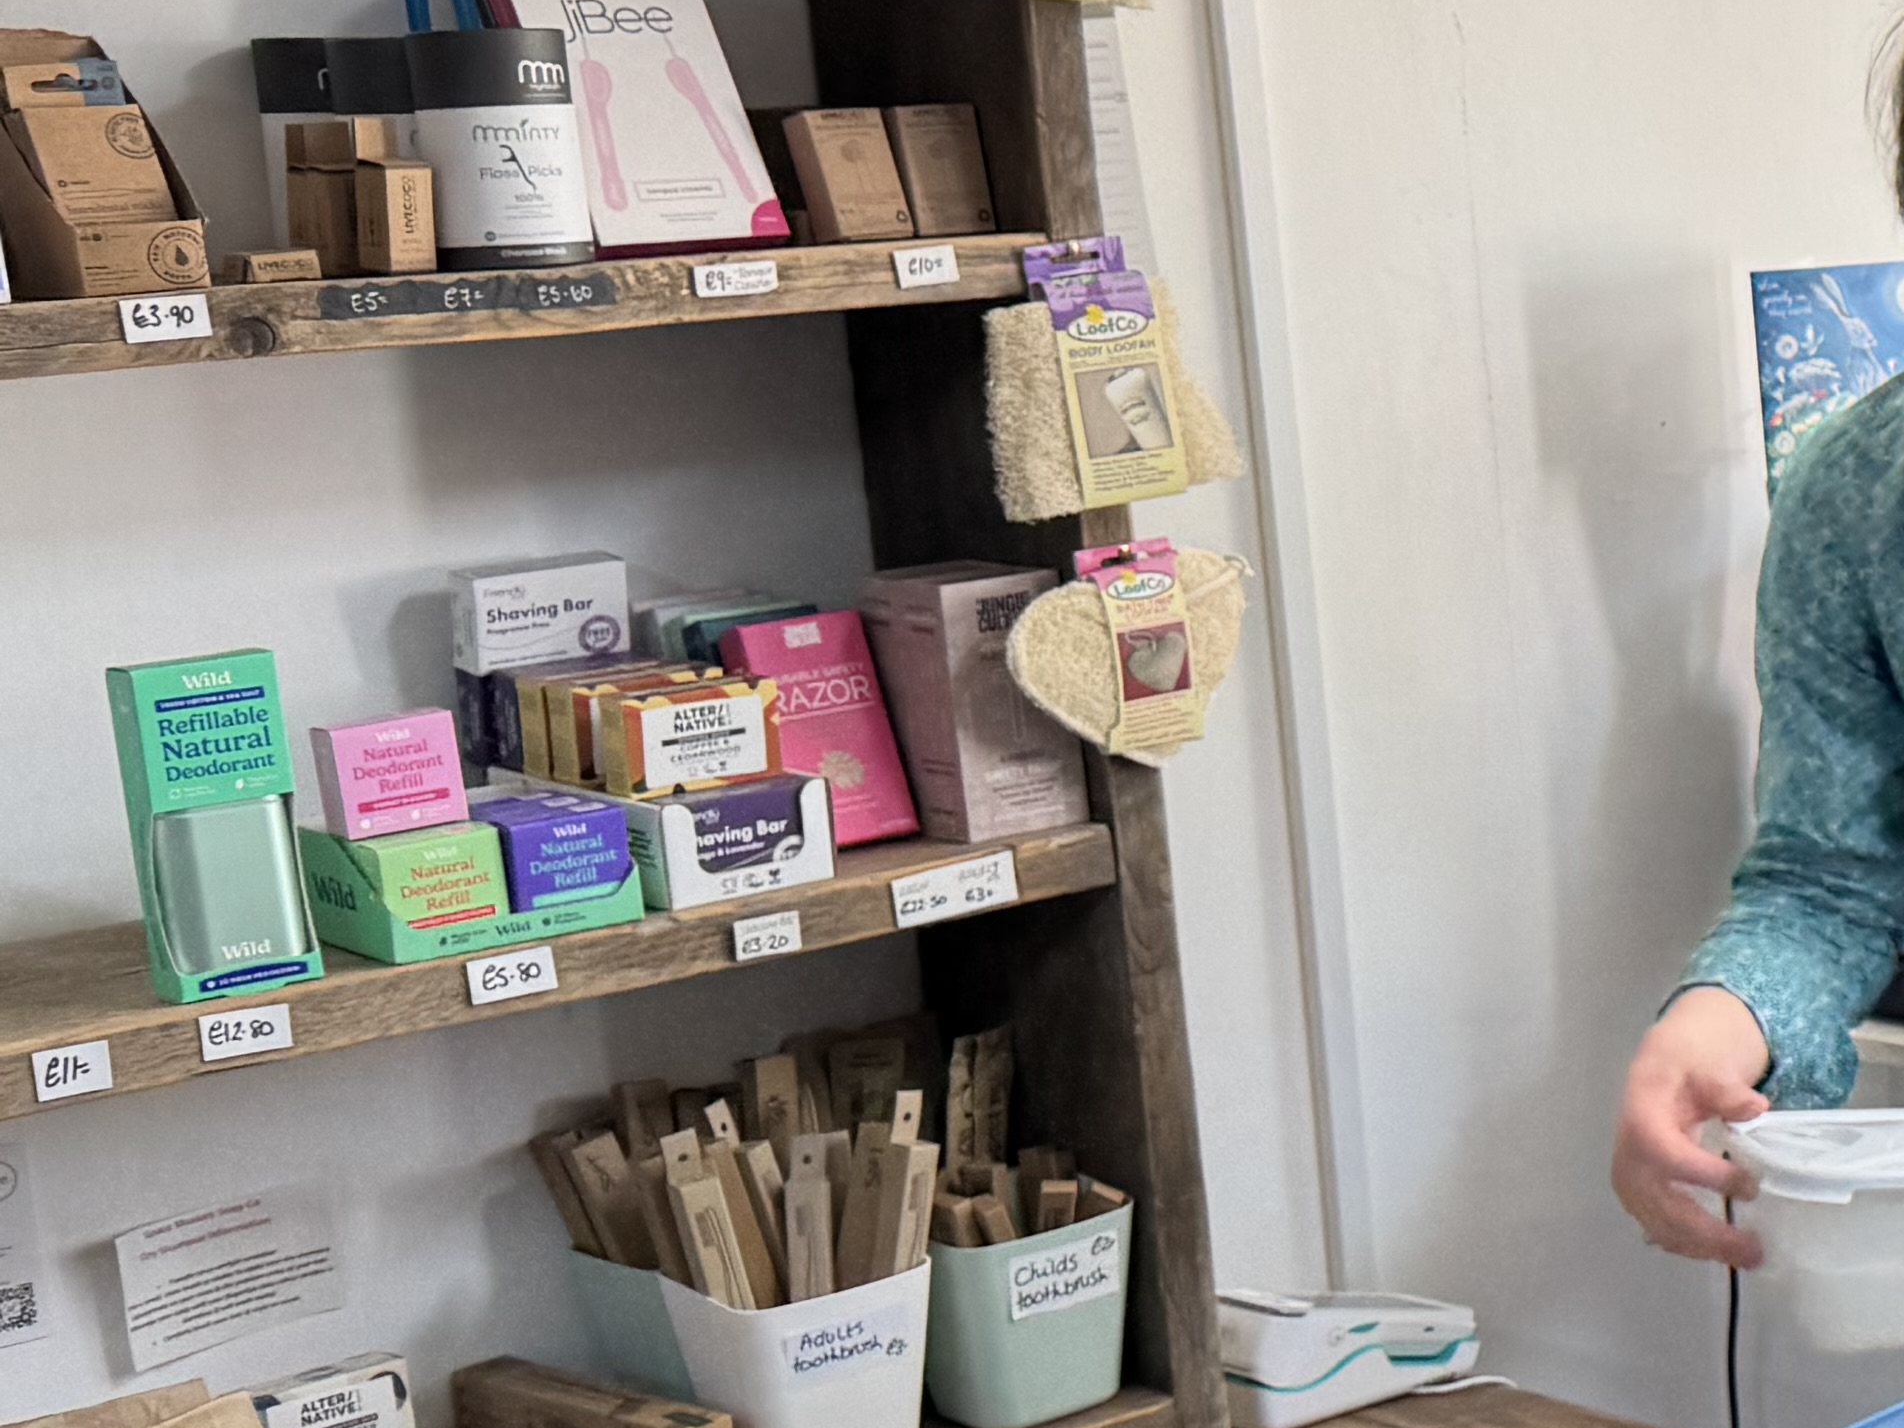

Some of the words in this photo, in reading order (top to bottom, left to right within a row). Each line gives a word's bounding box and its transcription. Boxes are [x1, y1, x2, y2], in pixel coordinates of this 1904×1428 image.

[1075, 318, 1140, 339] LoofCo
[486, 601, 559, 626] Shaving
[563, 597, 594, 614] Bar
[181, 670, 232, 690] Wild
[157, 704, 270, 739] Refillable
[674, 716, 725, 734] NATIVE
[161, 726, 273, 762] Natural
[362, 739, 429, 763] Natural
[165, 754, 277, 783] Deodorant
[352, 754, 445, 781] Deodorant
[378, 774, 424, 794] Refill
[552, 822, 587, 839] Wild
[756, 817, 789, 836] Bar
[540, 834, 603, 858] Natural
[410, 856, 476, 880] Natural
[529, 848, 629, 875] Deodorant
[400, 872, 492, 900] Deodorant
[554, 870, 598, 889] Refill
[311, 872, 357, 912] Wild
[426, 891, 472, 911] Refill
[221, 939, 271, 961] Wild
[1017, 1265, 1108, 1312] toothbrush
[801, 1320, 864, 1352] Adults
[301, 1401, 357, 1428] NATIVE
